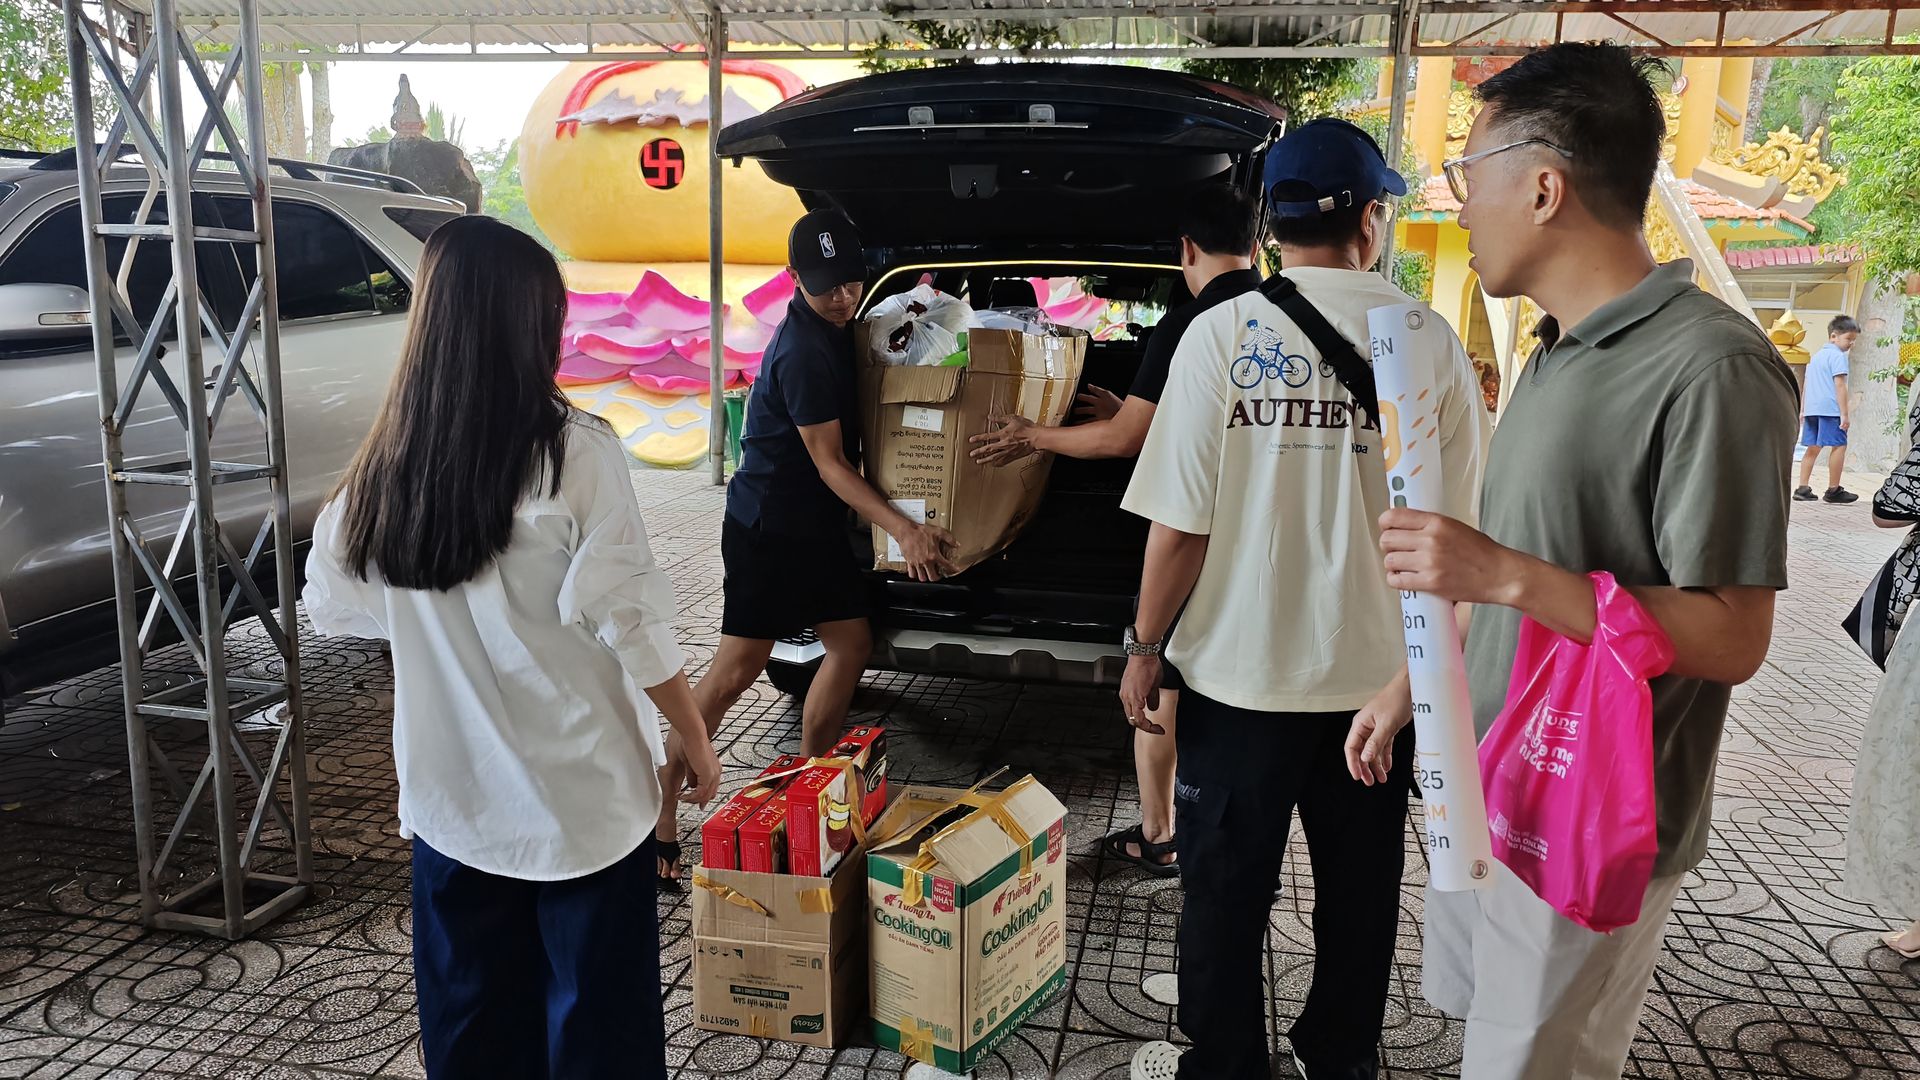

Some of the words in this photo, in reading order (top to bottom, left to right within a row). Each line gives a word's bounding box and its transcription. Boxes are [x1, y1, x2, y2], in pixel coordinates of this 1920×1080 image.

[1226, 398, 1380, 432] AUTHENT
[1420, 769, 1444, 790] 25
[980, 882, 1053, 958] CookingOil
[792, 1019, 822, 1031] Knorr
[975, 1045, 988, 1063] AN
[1010, 1011, 1026, 1031] CHO
